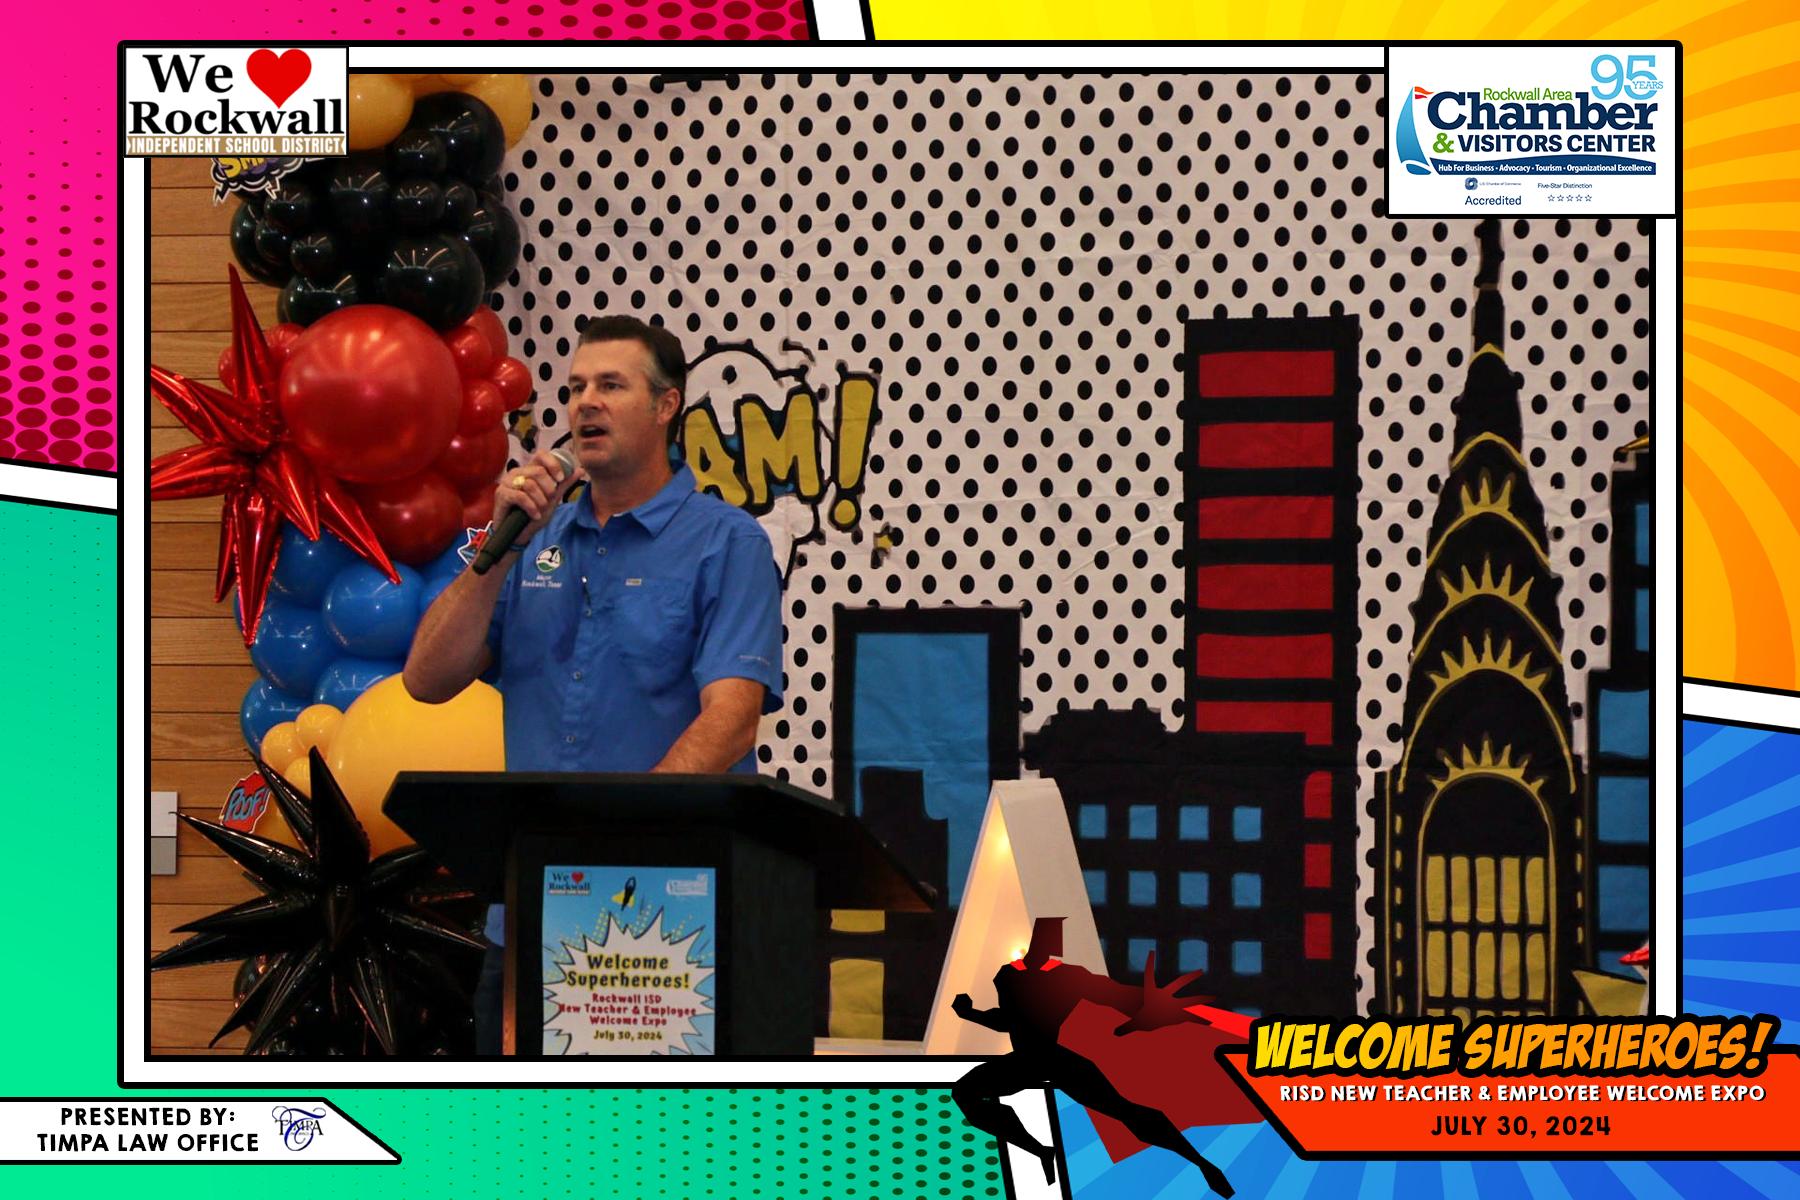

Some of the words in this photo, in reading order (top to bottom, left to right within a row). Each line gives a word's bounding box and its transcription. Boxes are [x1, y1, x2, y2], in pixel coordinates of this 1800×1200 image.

[680, 374, 878, 530] AM!
[587, 954, 669, 970] Welcome
[567, 971, 690, 989] Superheroes!
[592, 993, 641, 1004] Rockwall
[645, 994, 662, 1004] ISD
[559, 1003, 581, 1014] New
[584, 1003, 628, 1014] Teacher
[632, 1005, 641, 1015] &
[644, 1004, 697, 1018] Employee
[590, 1015, 638, 1025] Welcome
[642, 1016, 667, 1027] Expo
[594, 1030, 615, 1042] July
[618, 1031, 634, 1042] 30,
[637, 1031, 663, 1040] 2024
